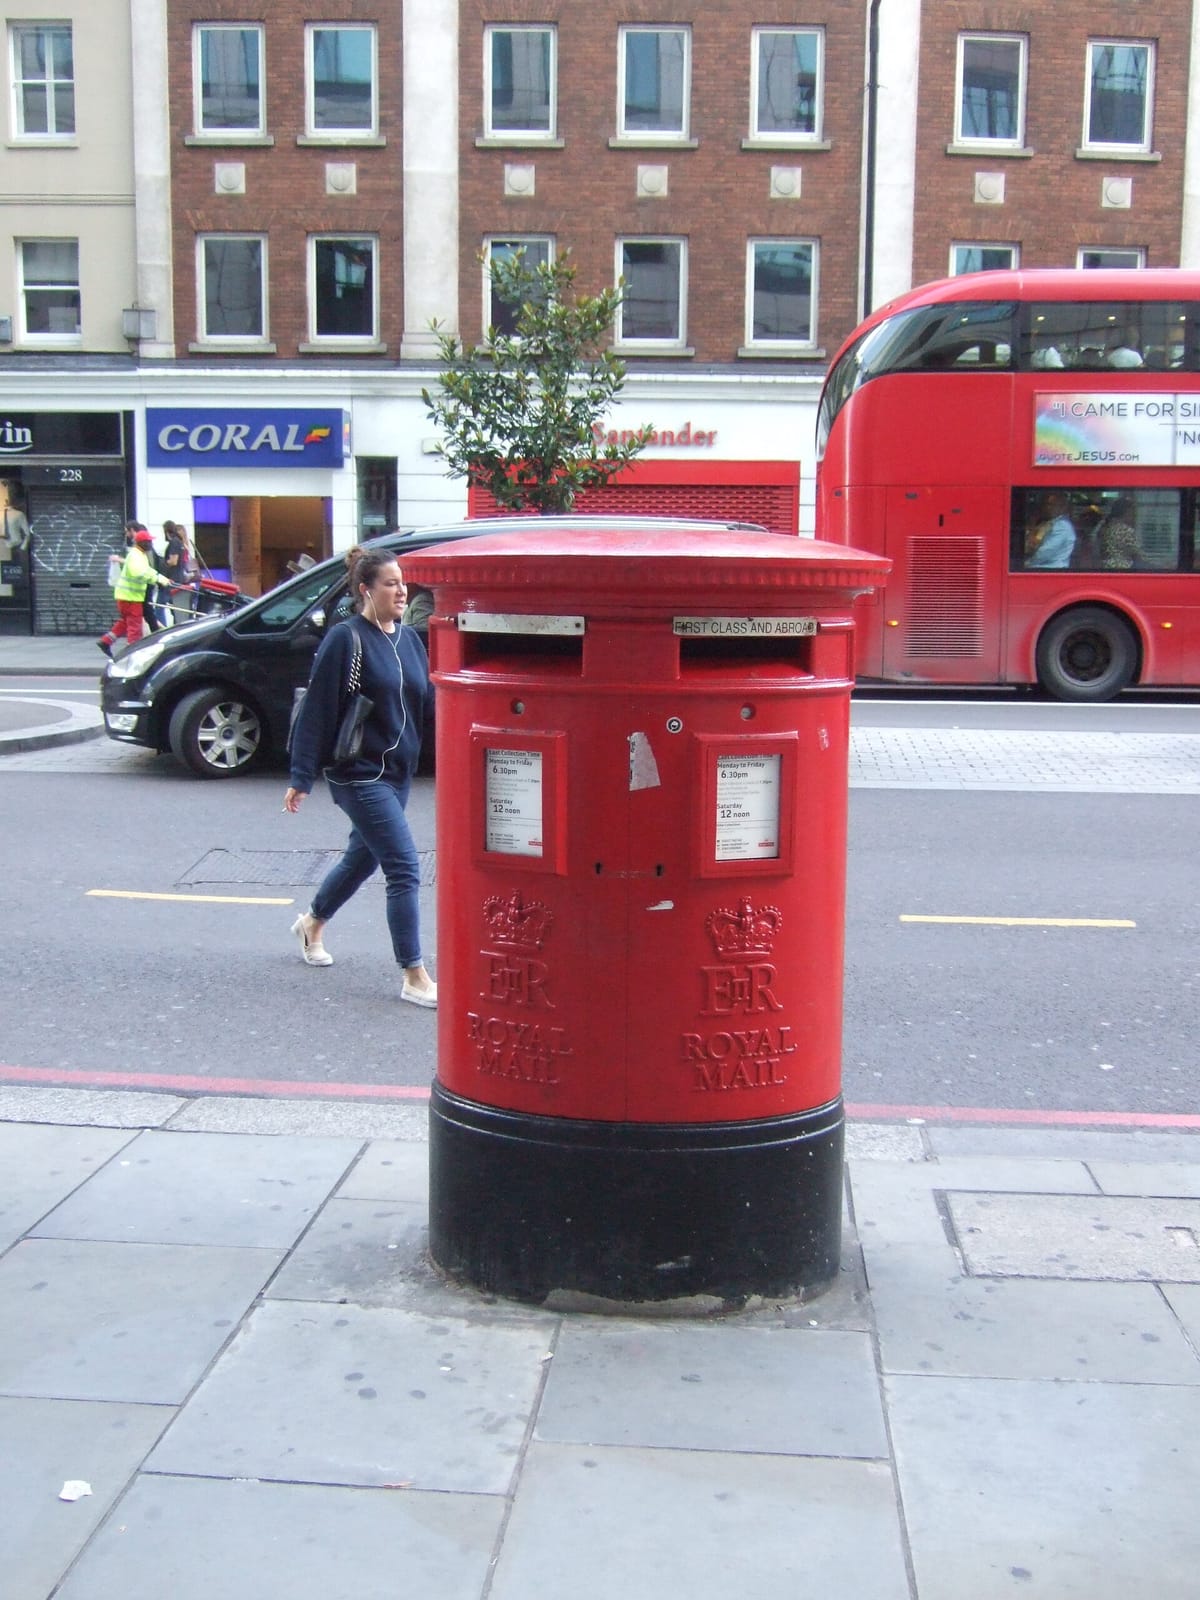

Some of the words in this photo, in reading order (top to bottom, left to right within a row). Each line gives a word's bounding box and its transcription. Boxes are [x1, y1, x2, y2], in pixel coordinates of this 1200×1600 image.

[1071, 402, 1128, 417] CAME
[1134, 402, 1174, 417] FOR
[1180, 402, 1200, 417] SI
[158, 424, 305, 451] CORAL
[60, 469, 82, 481] 228
[675, 621, 708, 633] FIRST
[711, 622, 747, 633] CLASS
[751, 622, 772, 633] AND
[493, 765, 518, 775] 6.30pm
[721, 770, 748, 779] 6.30pm
[489, 797, 513, 805] Saturday
[494, 804, 504, 813] 12
[720, 810, 732, 818] 12
[468, 1012, 573, 1054] ROYAL
[681, 1027, 798, 1060] ROYAL
[476, 1045, 560, 1083] MAIL
[694, 1058, 788, 1090] MAIL
